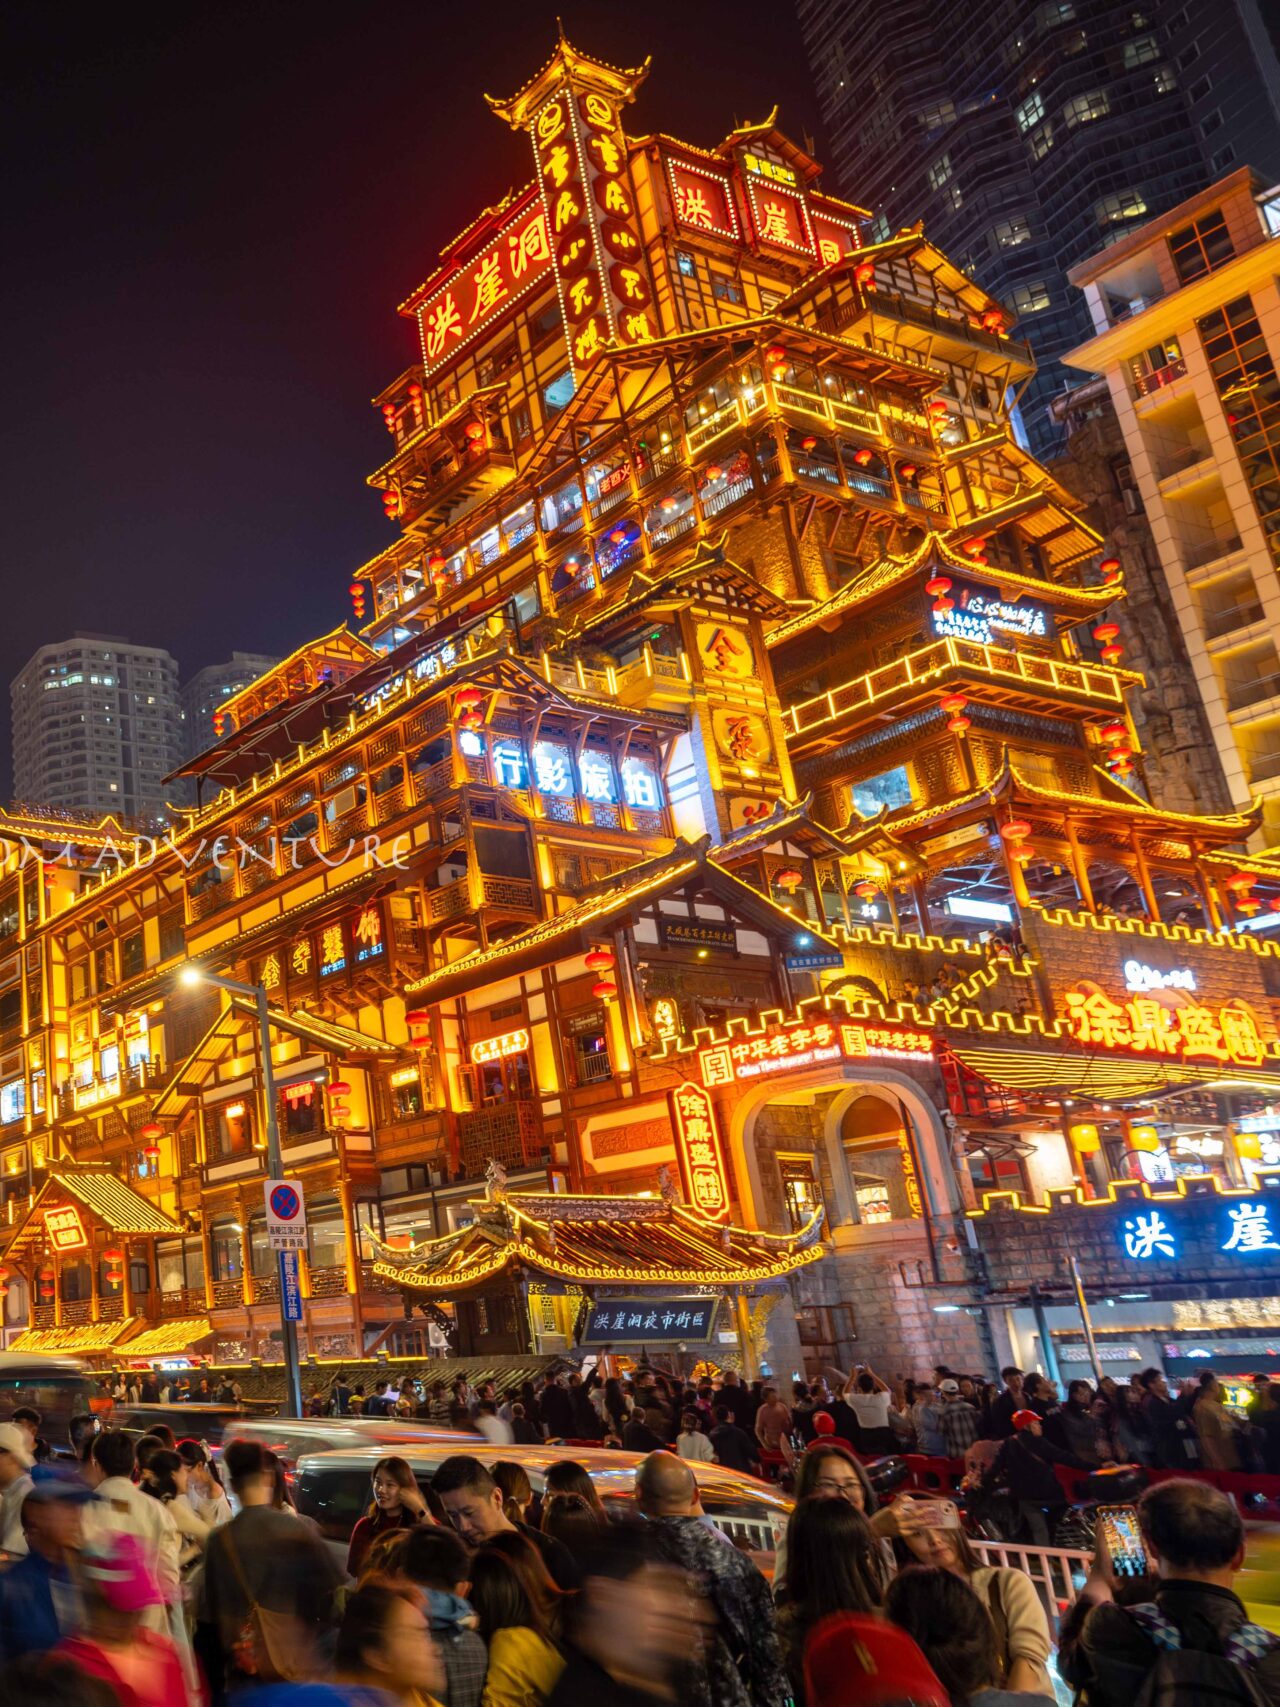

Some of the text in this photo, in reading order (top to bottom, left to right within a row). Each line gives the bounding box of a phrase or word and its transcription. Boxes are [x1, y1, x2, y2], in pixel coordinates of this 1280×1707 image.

[426, 214, 551, 358] 洪崖洞
[731, 1024, 834, 1063] 中华老字号
[865, 1029, 932, 1051] 中华老字号
[1064, 992, 1230, 1061] 徐鼎盛
[679, 1094, 717, 1167] 徐鼎盛
[273, 1238, 305, 1248] 严管路段
[283, 1252, 299, 1319] 嘉陵江滨江路
